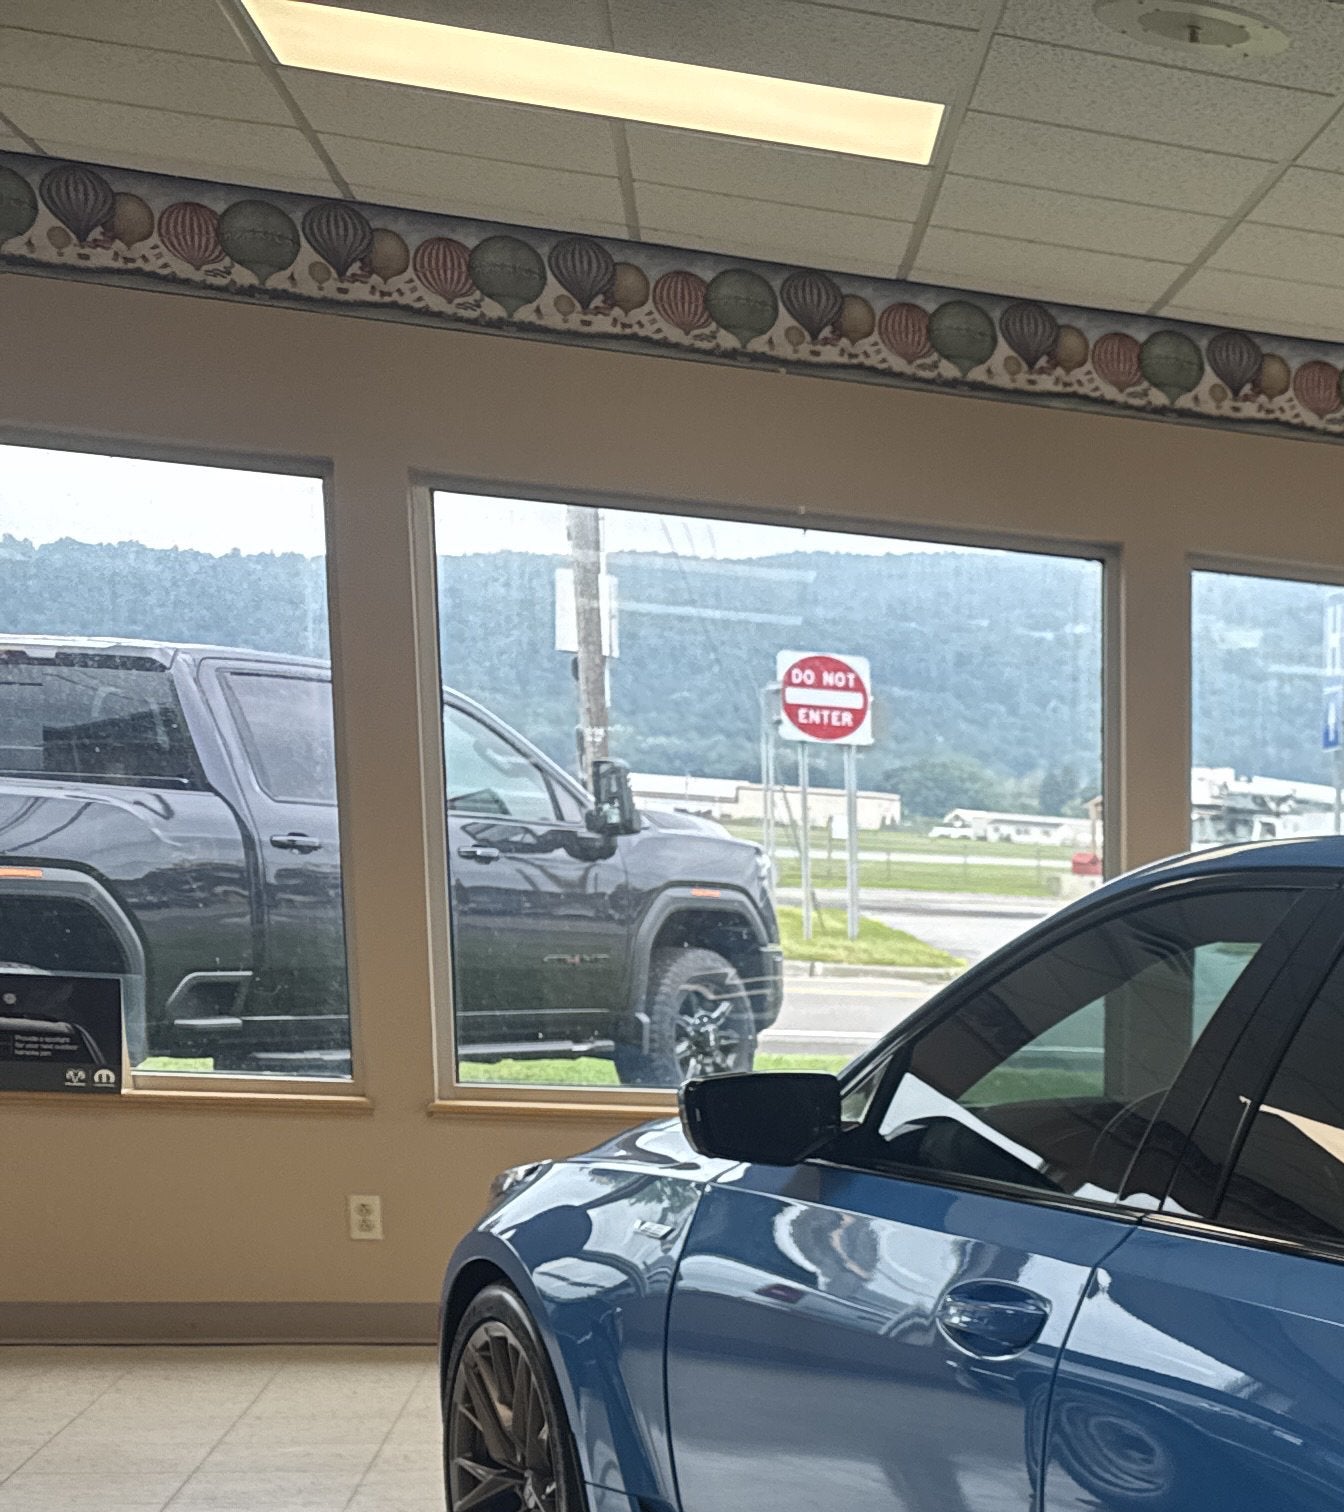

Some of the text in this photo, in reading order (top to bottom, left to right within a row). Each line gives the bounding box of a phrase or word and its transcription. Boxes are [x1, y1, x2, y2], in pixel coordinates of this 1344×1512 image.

[791, 668, 856, 688] DO NOT
[798, 707, 854, 728] ENTER
